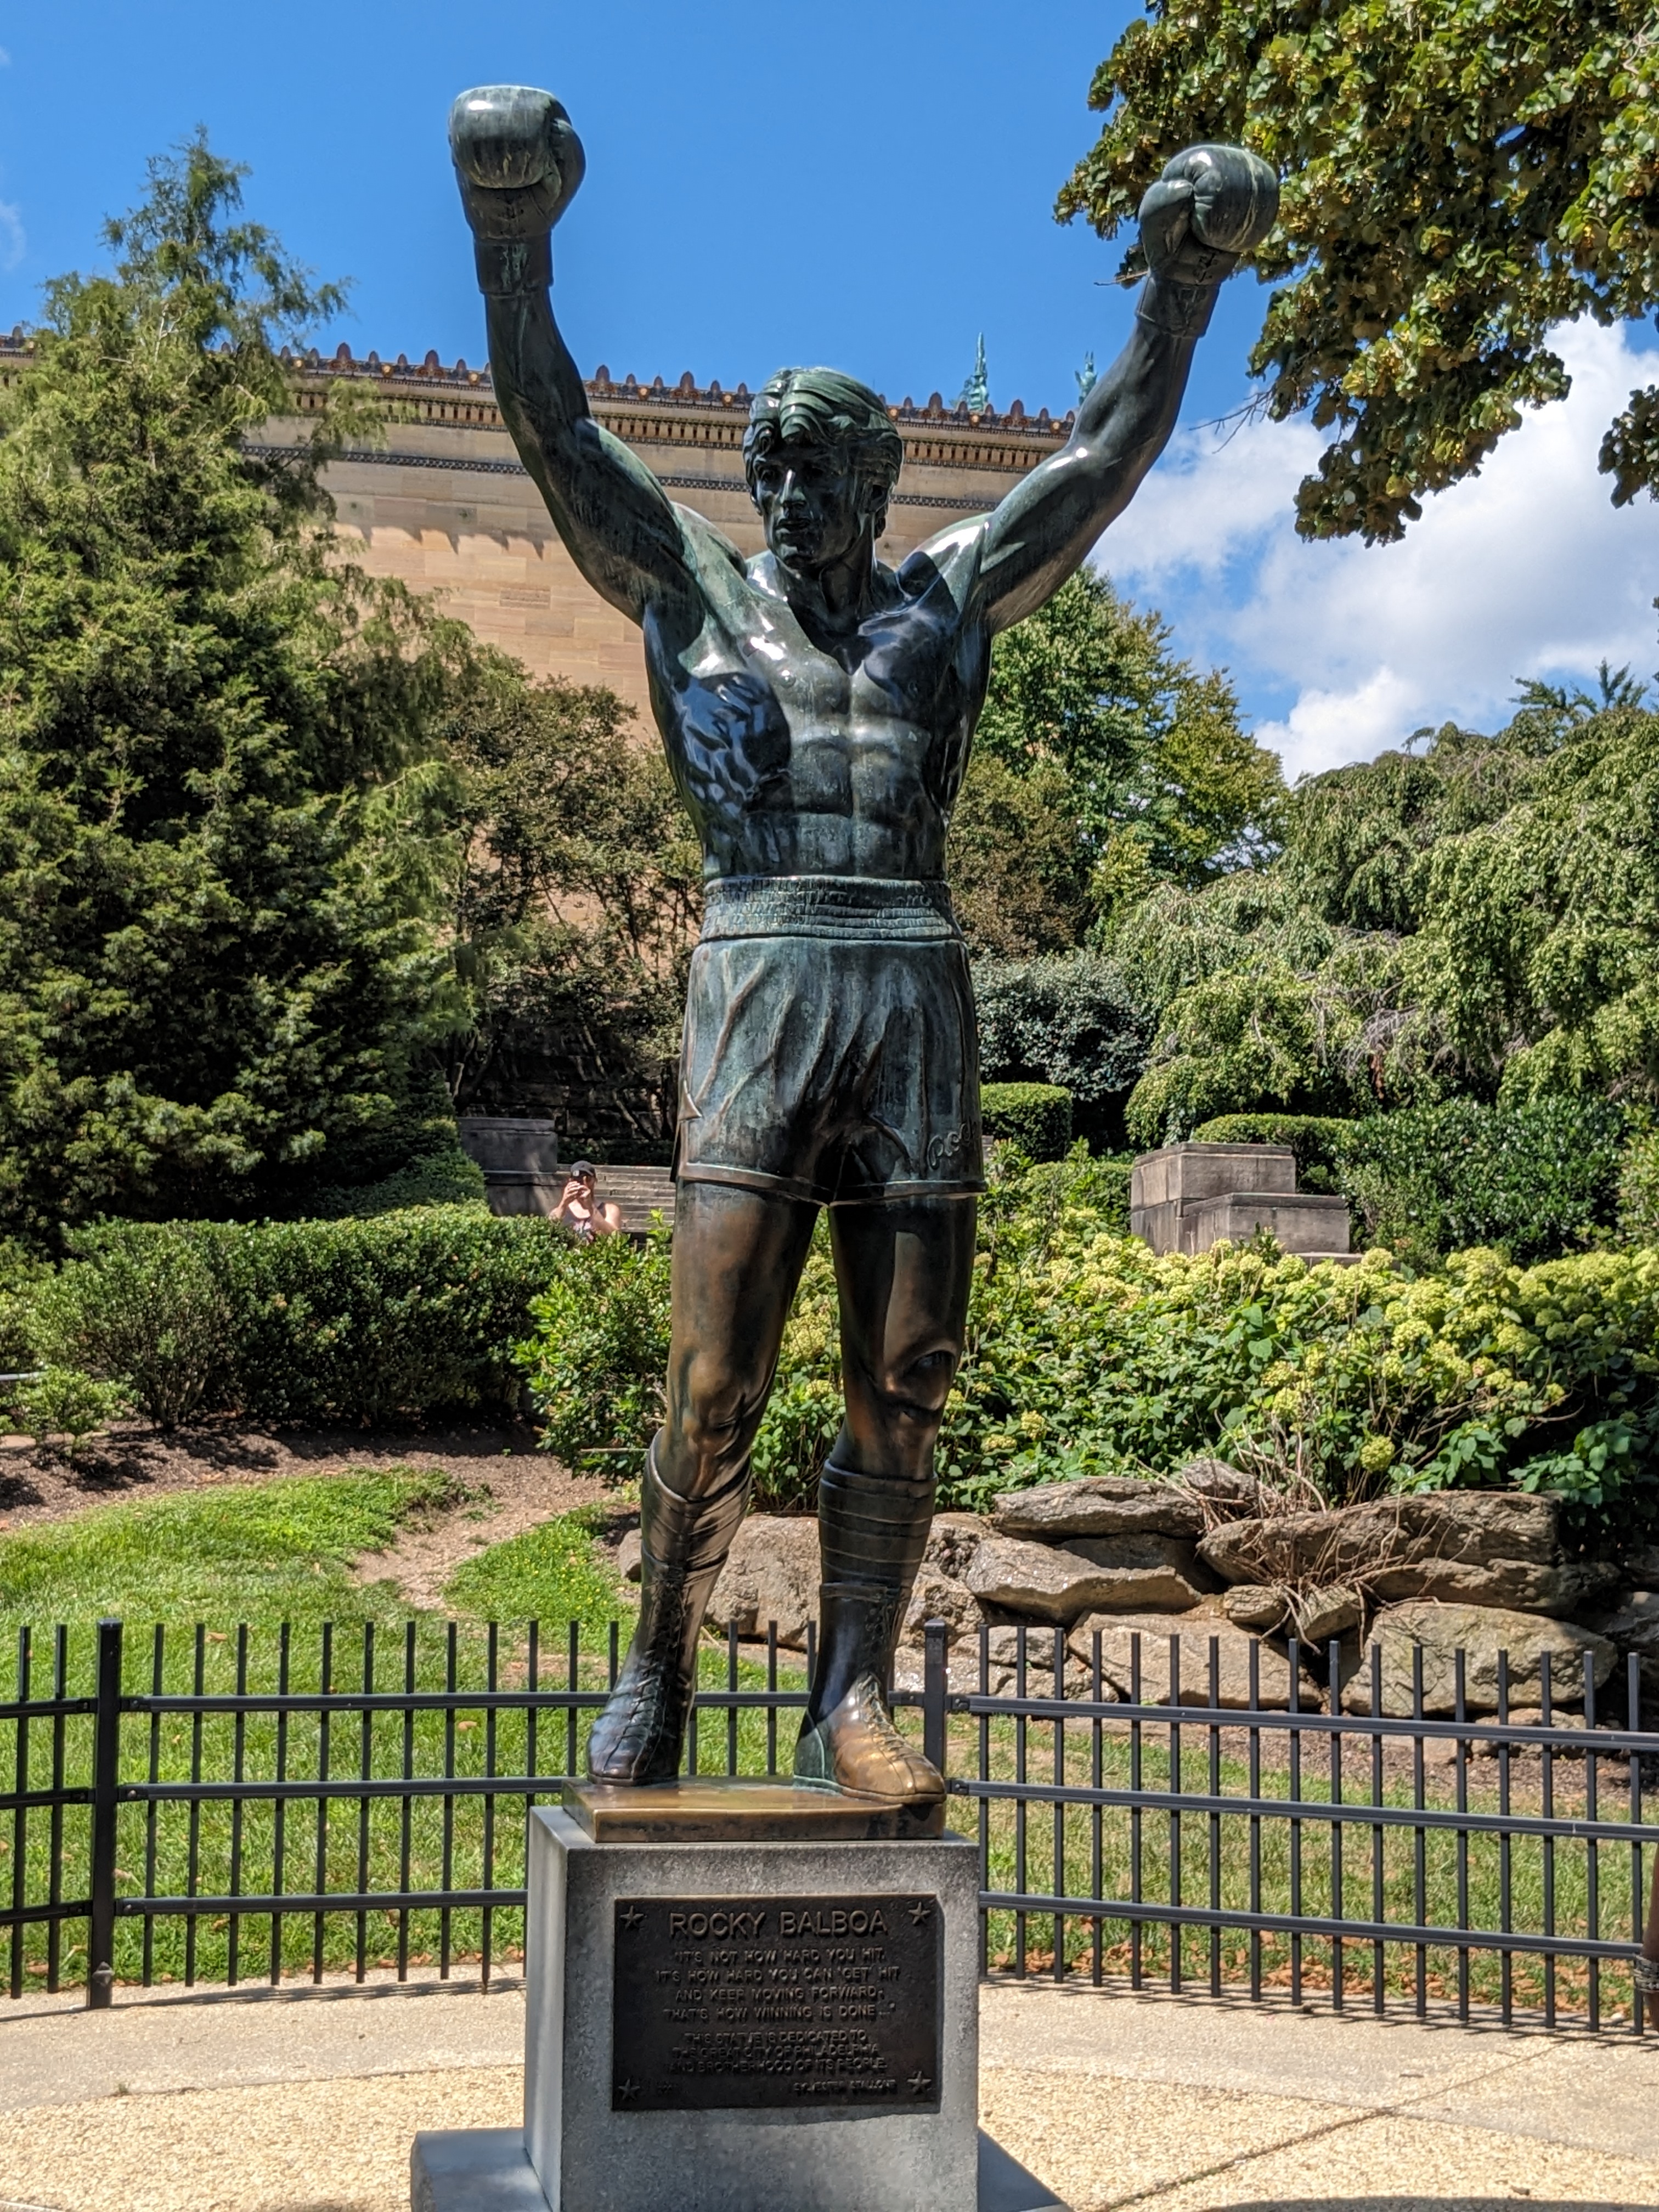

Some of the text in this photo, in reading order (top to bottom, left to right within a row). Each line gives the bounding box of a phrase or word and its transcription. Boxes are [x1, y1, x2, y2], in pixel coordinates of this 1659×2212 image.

[669, 1910, 888, 1937] ROCKY BALBOA
[710, 1951, 738, 1962] NOT
[744, 1950, 777, 1962] HOW
[783, 1949, 820, 1961] HARD
[826, 1948, 855, 1960] YOU
[688, 1970, 720, 1982] HOW
[727, 1969, 762, 1981] HARD
[769, 1968, 798, 1980] YOU
[804, 1967, 832, 1979] CAN
[878, 1966, 899, 1977] HIT
[675, 1990, 702, 2000] AND
[710, 1989, 744, 2000] KEEP
[752, 1987, 804, 2000] MOVING
[663, 2008, 708, 2019] THAT'S
[716, 2007, 748, 2019] HOW
[754, 2006, 812, 2018] WINNING
[820, 2005, 831, 2017] IS
[684, 2032, 711, 2044] THIS
[716, 2032, 761, 2044] STATUE
[779, 2030, 847, 2042] DEDICATED
[850, 2029, 866, 2041] TO
[775, 2045, 791, 2057] OF
[794, 2043, 878, 2056] PHILADELPHIA
[796, 2058, 812, 2070] OF
